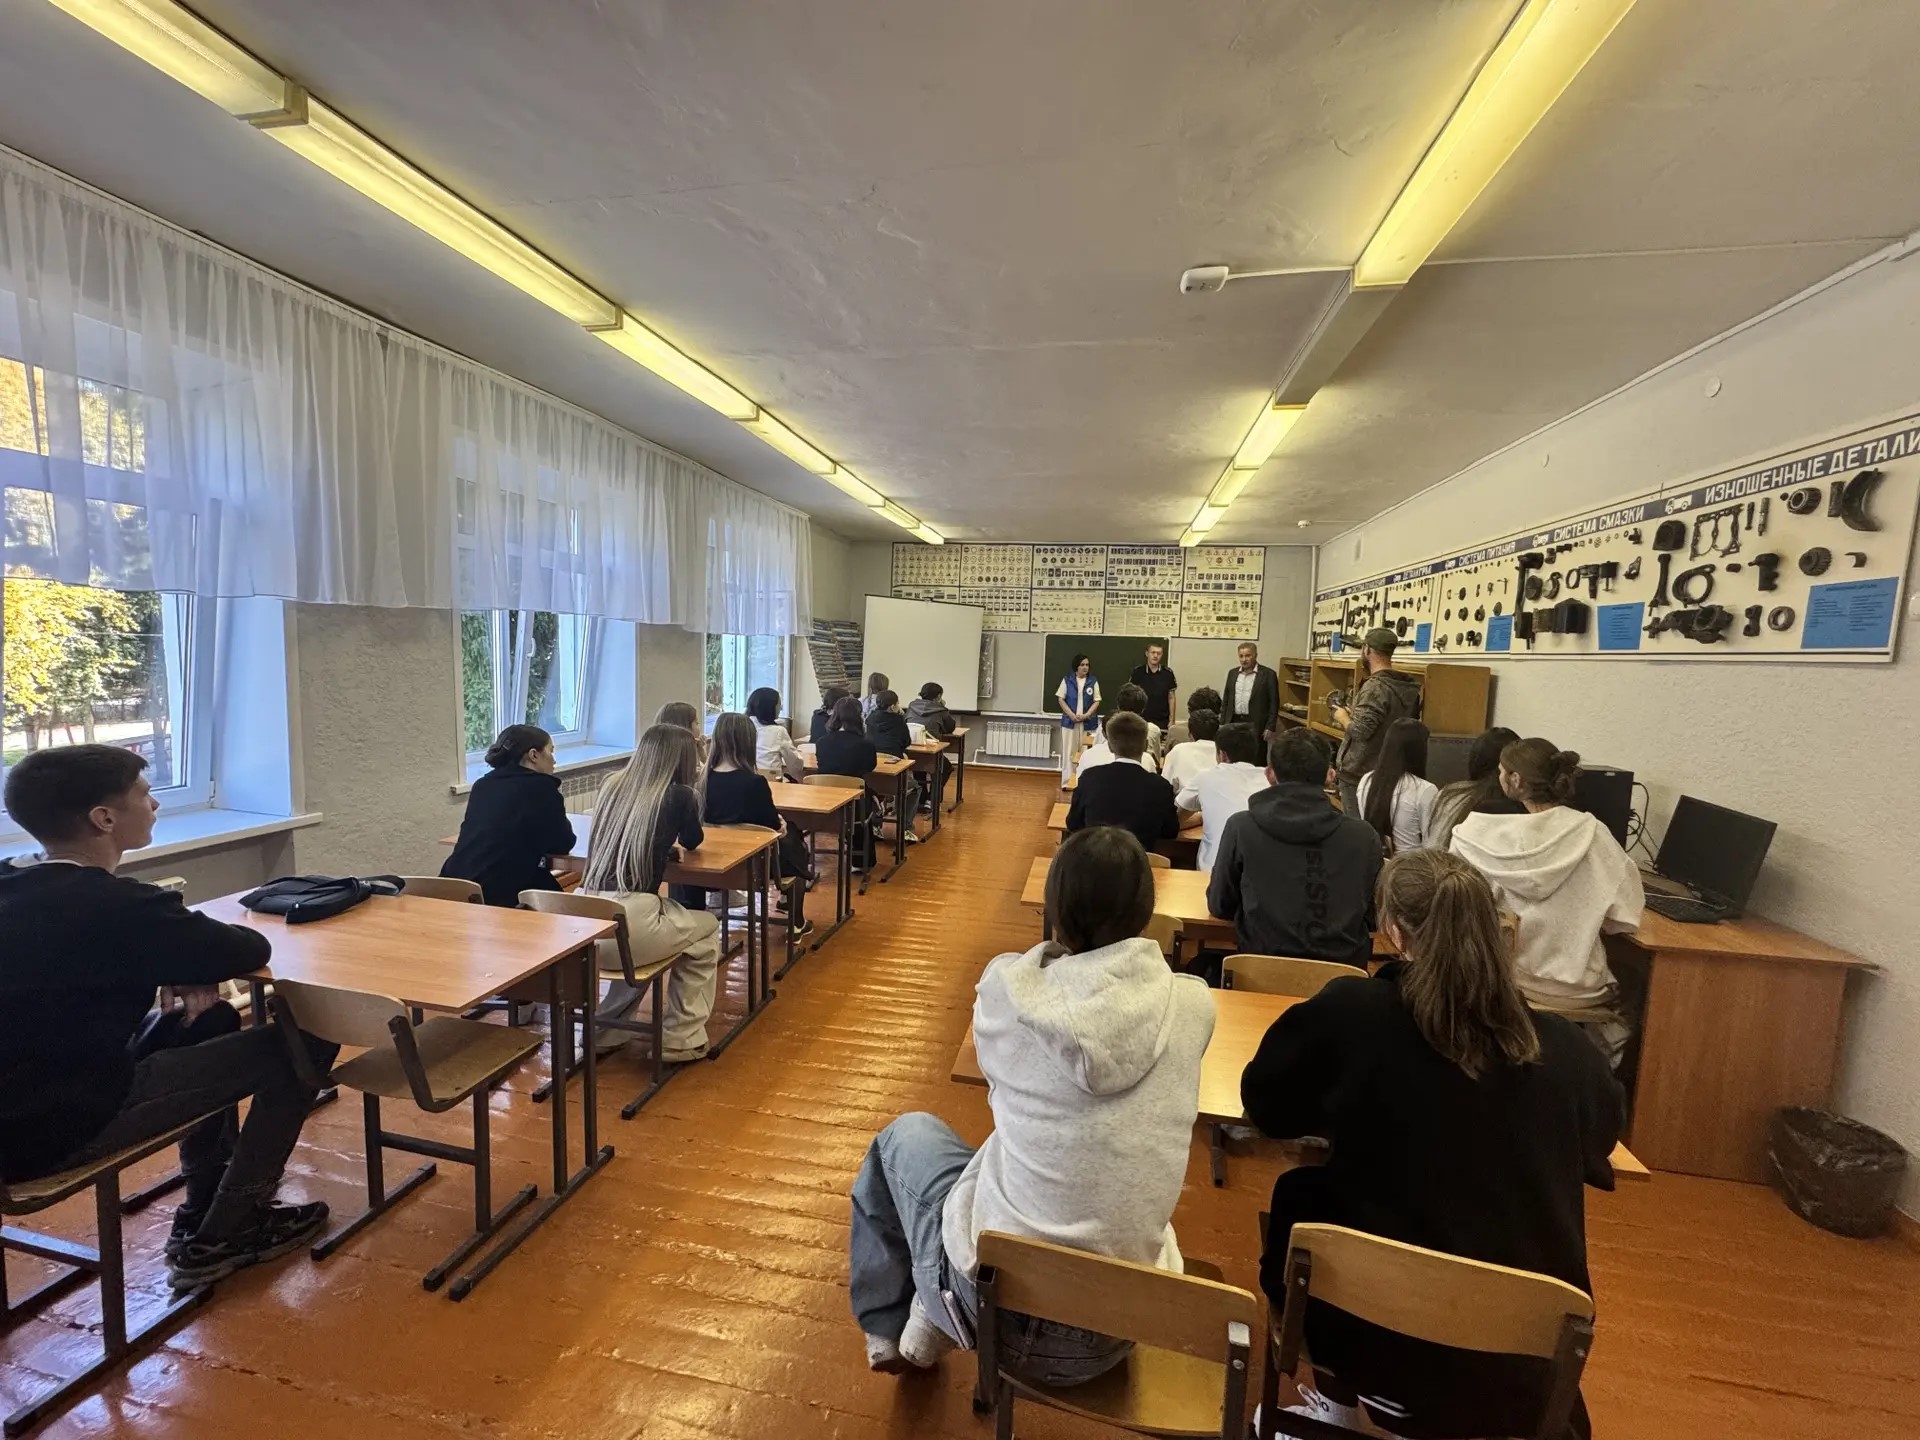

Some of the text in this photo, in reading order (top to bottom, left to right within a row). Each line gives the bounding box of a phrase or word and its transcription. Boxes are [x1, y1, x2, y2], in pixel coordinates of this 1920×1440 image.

[1705, 431, 1920, 504] ИЗНОШЕННЫЕ ДЕТАЛИ
[1554, 505, 1645, 542] СИСТЕМА СМАЗКИ
[1459, 550, 1486, 566] СИСТЕМА
